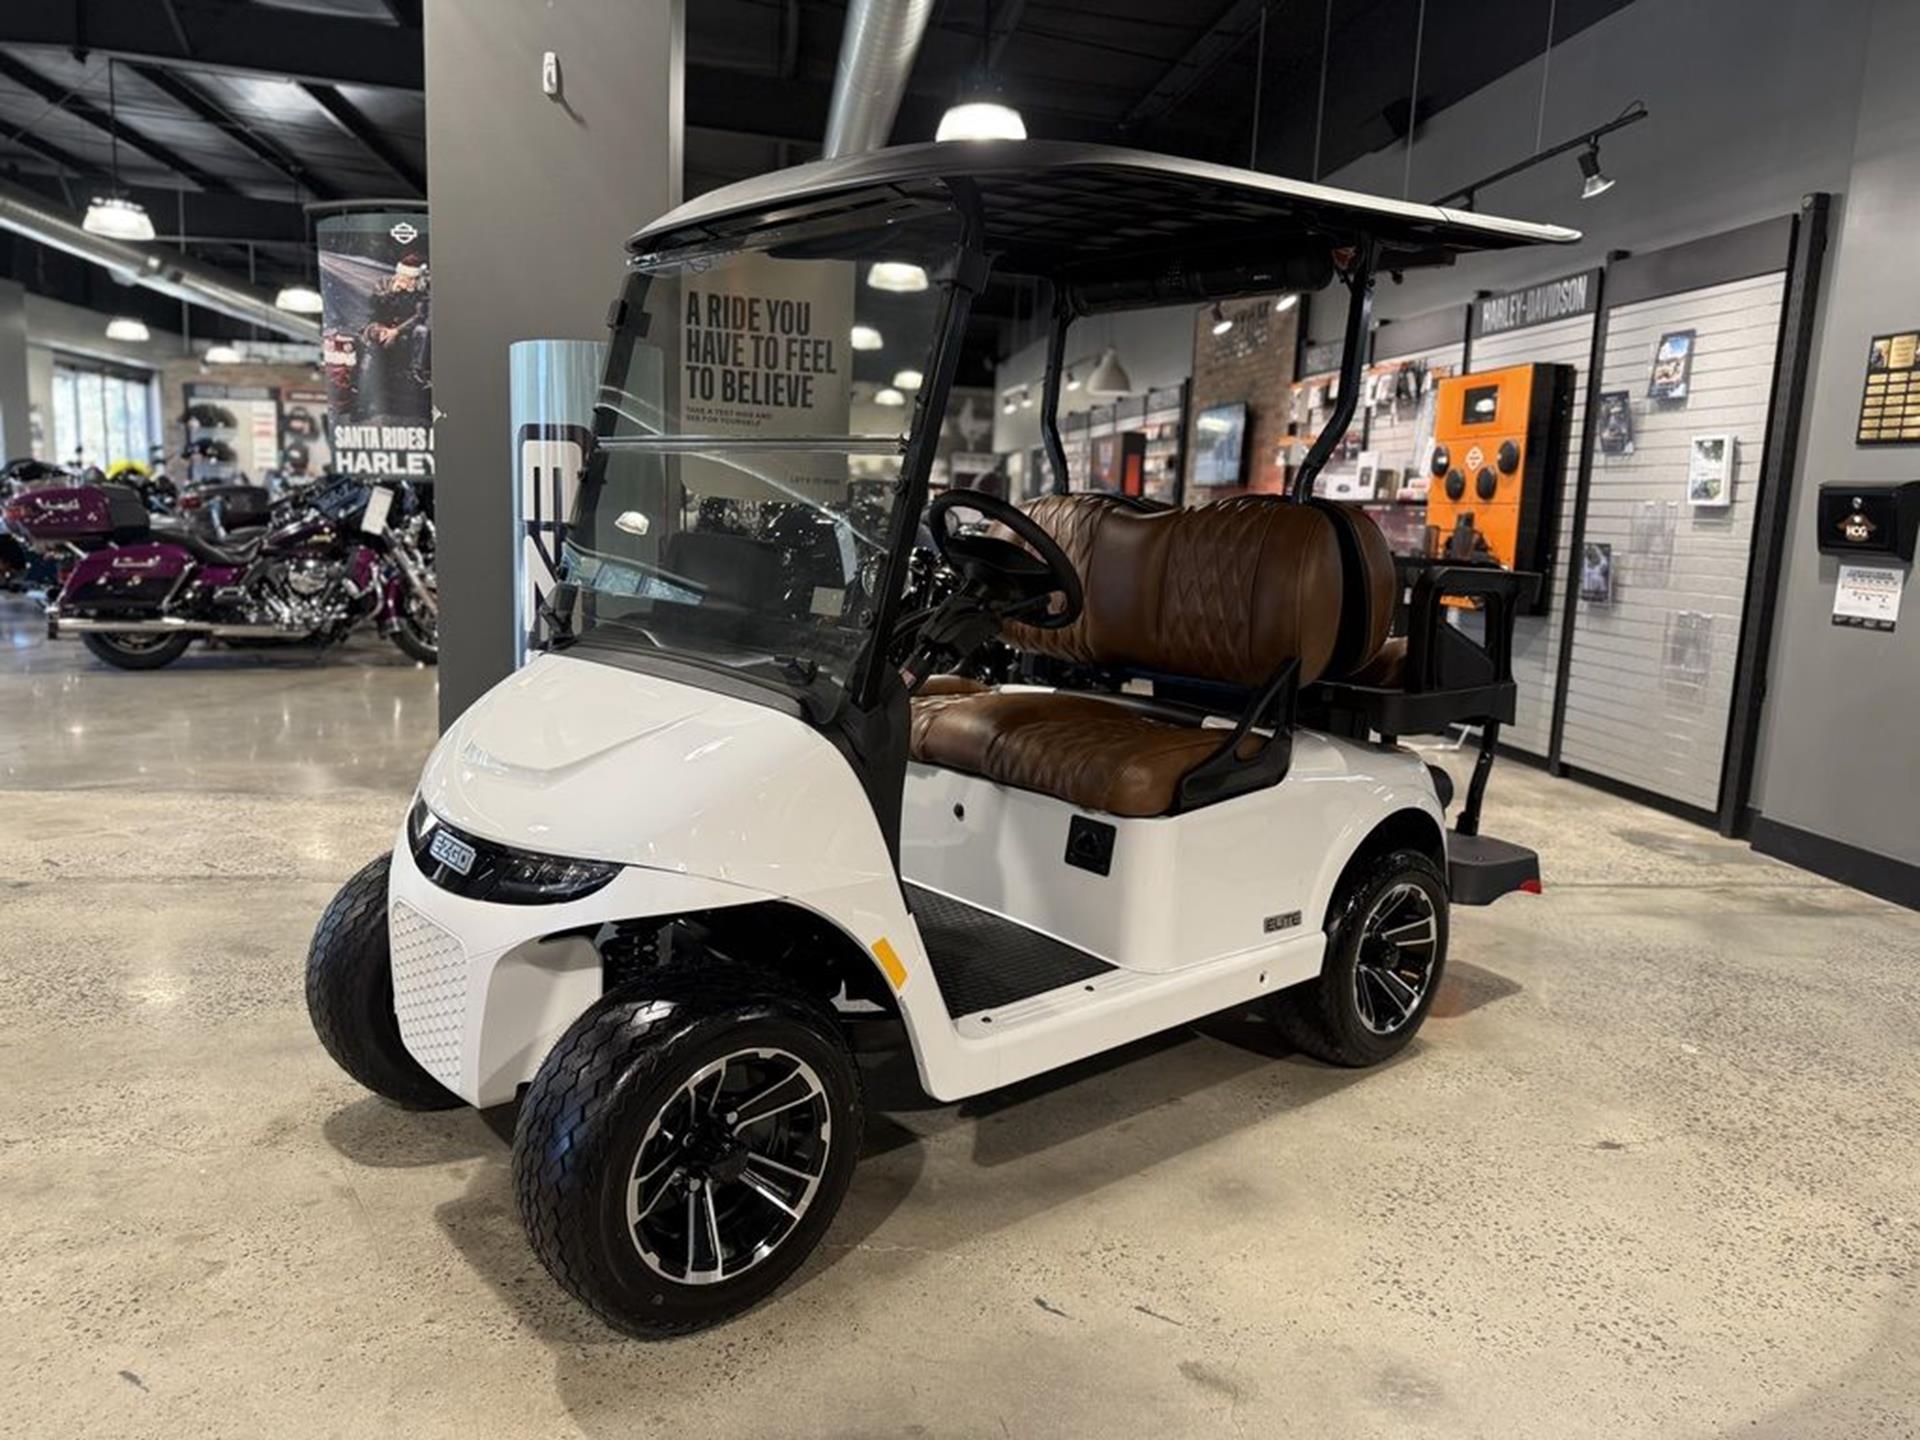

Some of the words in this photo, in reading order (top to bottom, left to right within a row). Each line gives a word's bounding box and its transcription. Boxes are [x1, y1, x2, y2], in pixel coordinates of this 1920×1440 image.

[686, 291, 701, 326] A
[707, 293, 761, 332] RIDE
[766, 299, 811, 336] YOU
[1482, 275, 1588, 333] HARLEY-DAVIDSON
[686, 328, 746, 368] HAVE
[750, 335, 779, 370] TO
[785, 338, 837, 375] FEEL
[685, 365, 715, 401] TO
[721, 369, 814, 409] BELIEVE
[334, 425, 380, 449] SANTA
[381, 427, 427, 451] RIDES
[430, 831, 473, 873] EZGO
[1263, 910, 1302, 933] ELITE
